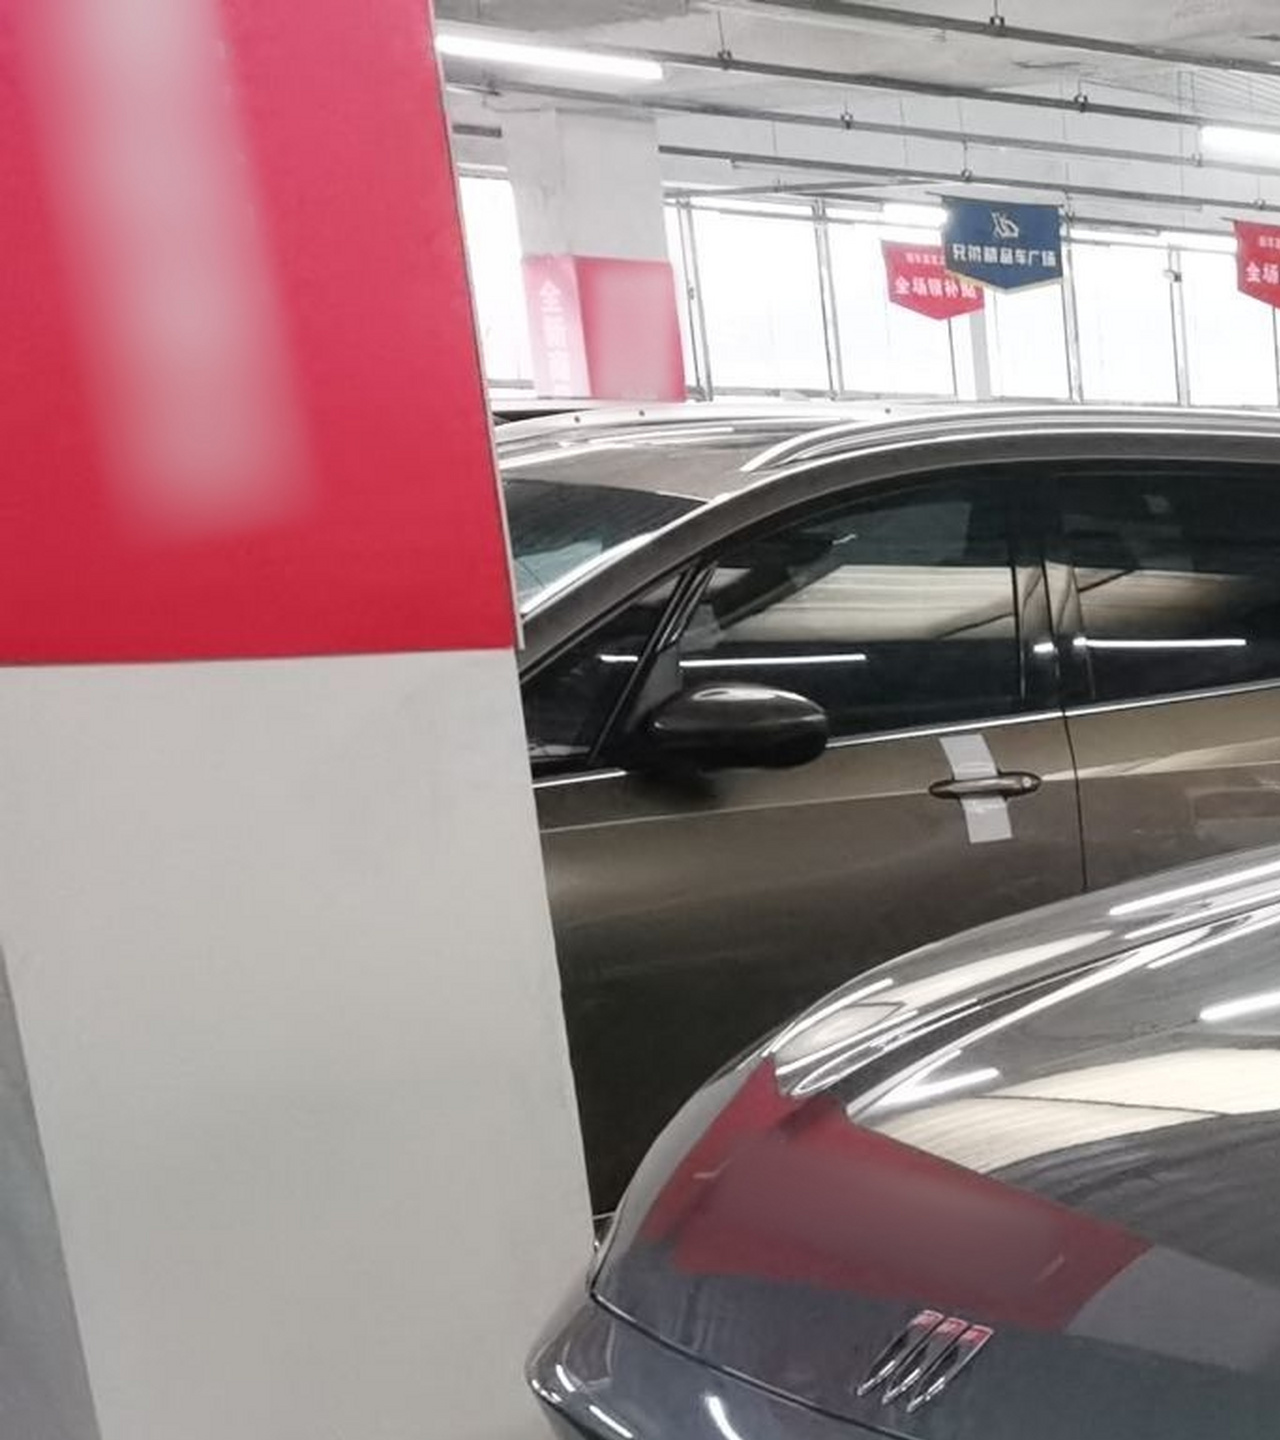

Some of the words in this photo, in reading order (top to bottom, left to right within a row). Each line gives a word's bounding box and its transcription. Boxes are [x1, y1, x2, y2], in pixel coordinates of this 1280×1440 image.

[951, 243, 1057, 267] 兄弟精品车广场
